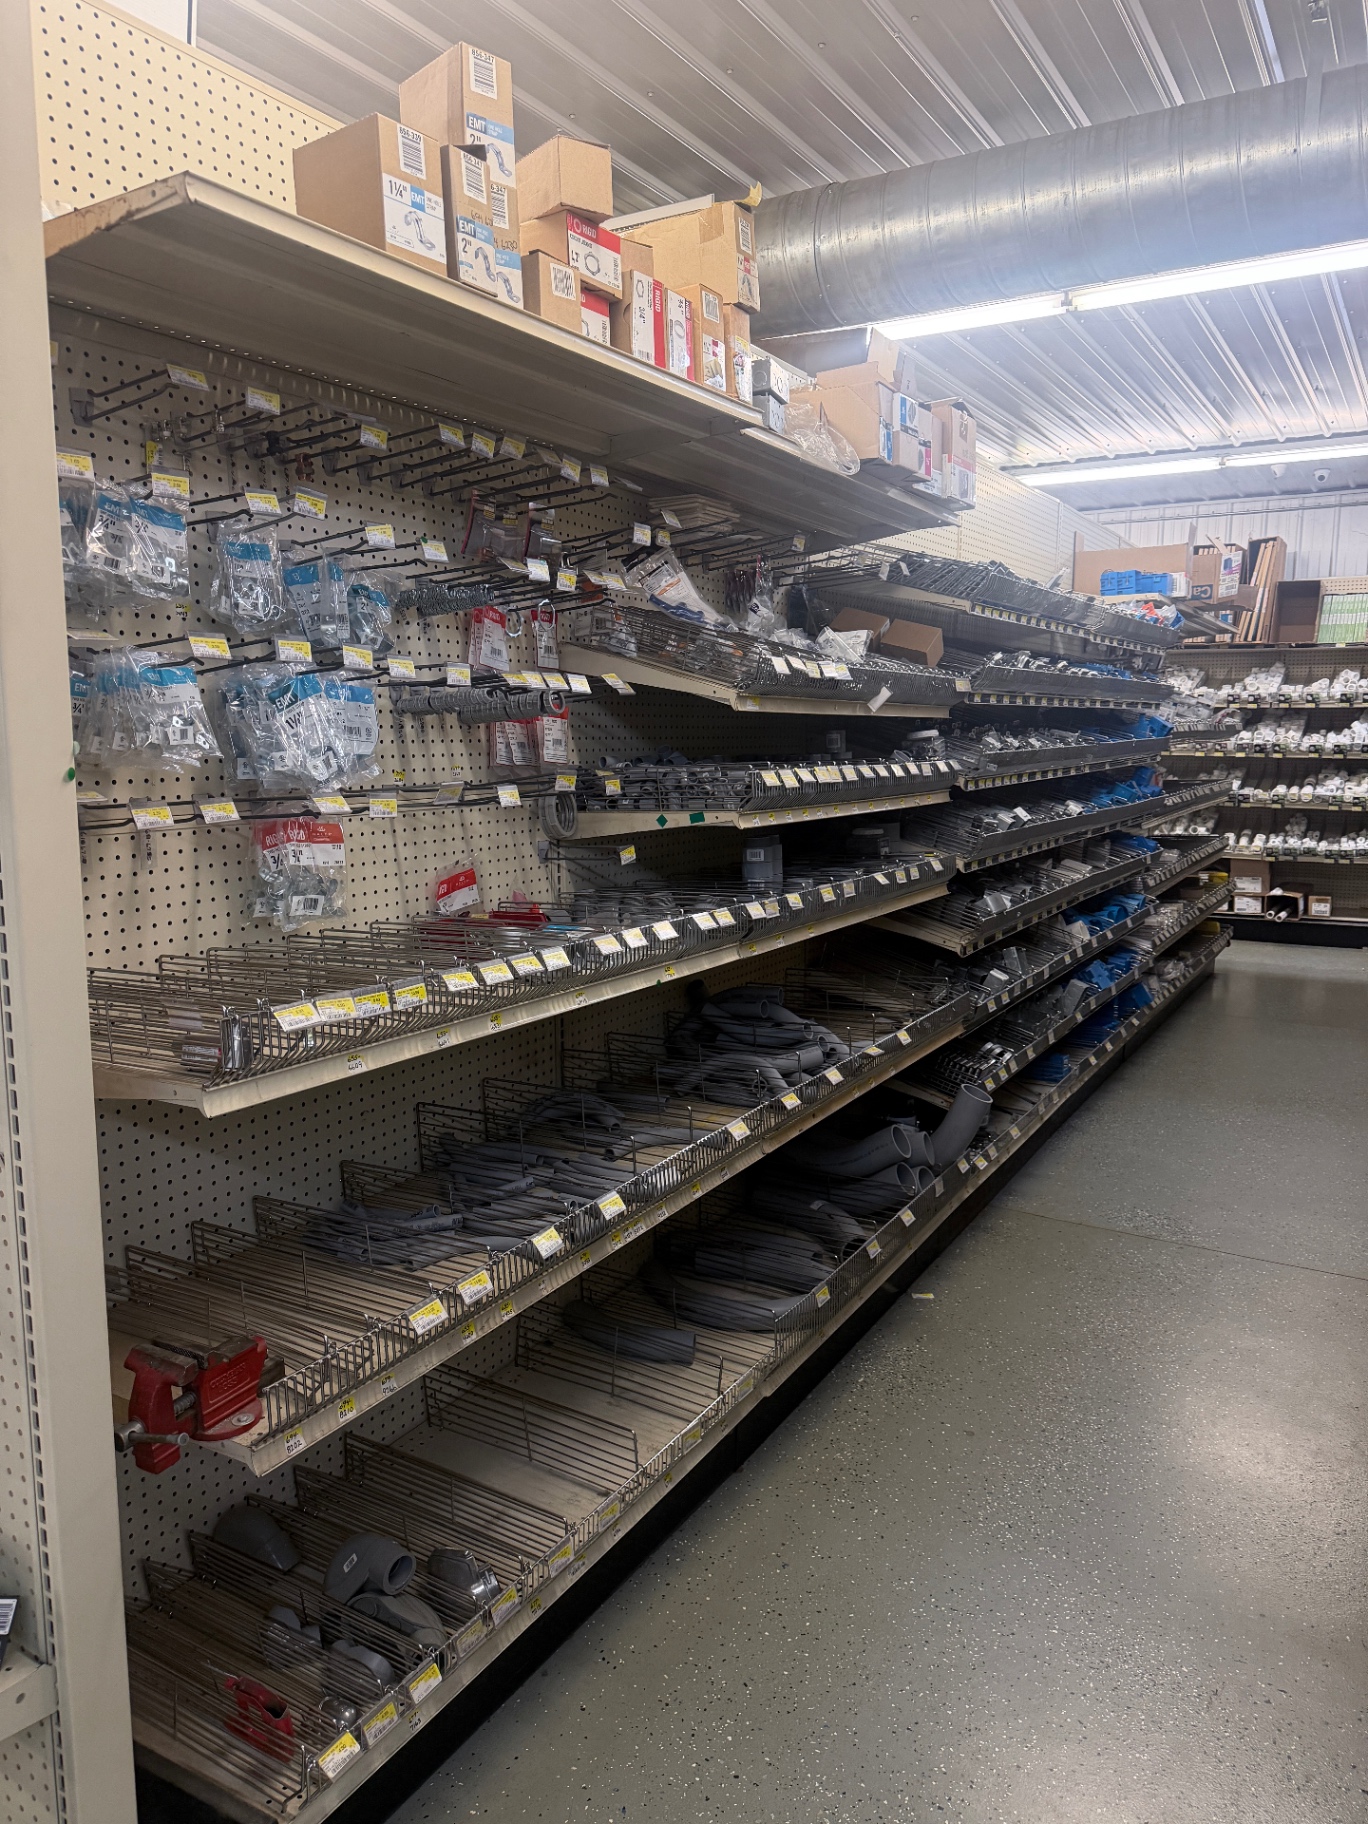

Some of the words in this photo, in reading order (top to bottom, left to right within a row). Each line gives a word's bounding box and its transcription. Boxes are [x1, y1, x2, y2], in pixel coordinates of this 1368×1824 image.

[472, 48, 494, 64] 856-347
[468, 115, 486, 132] EMT
[411, 191, 424, 206] EMT
[459, 220, 476, 236] EMT
[582, 224, 597, 238] RIGID
[461, 237, 472, 254] 2"
[654, 290, 662, 312] RIGID
[276, 692, 298, 710] EMT
[286, 1440, 303, 1455] 8202
